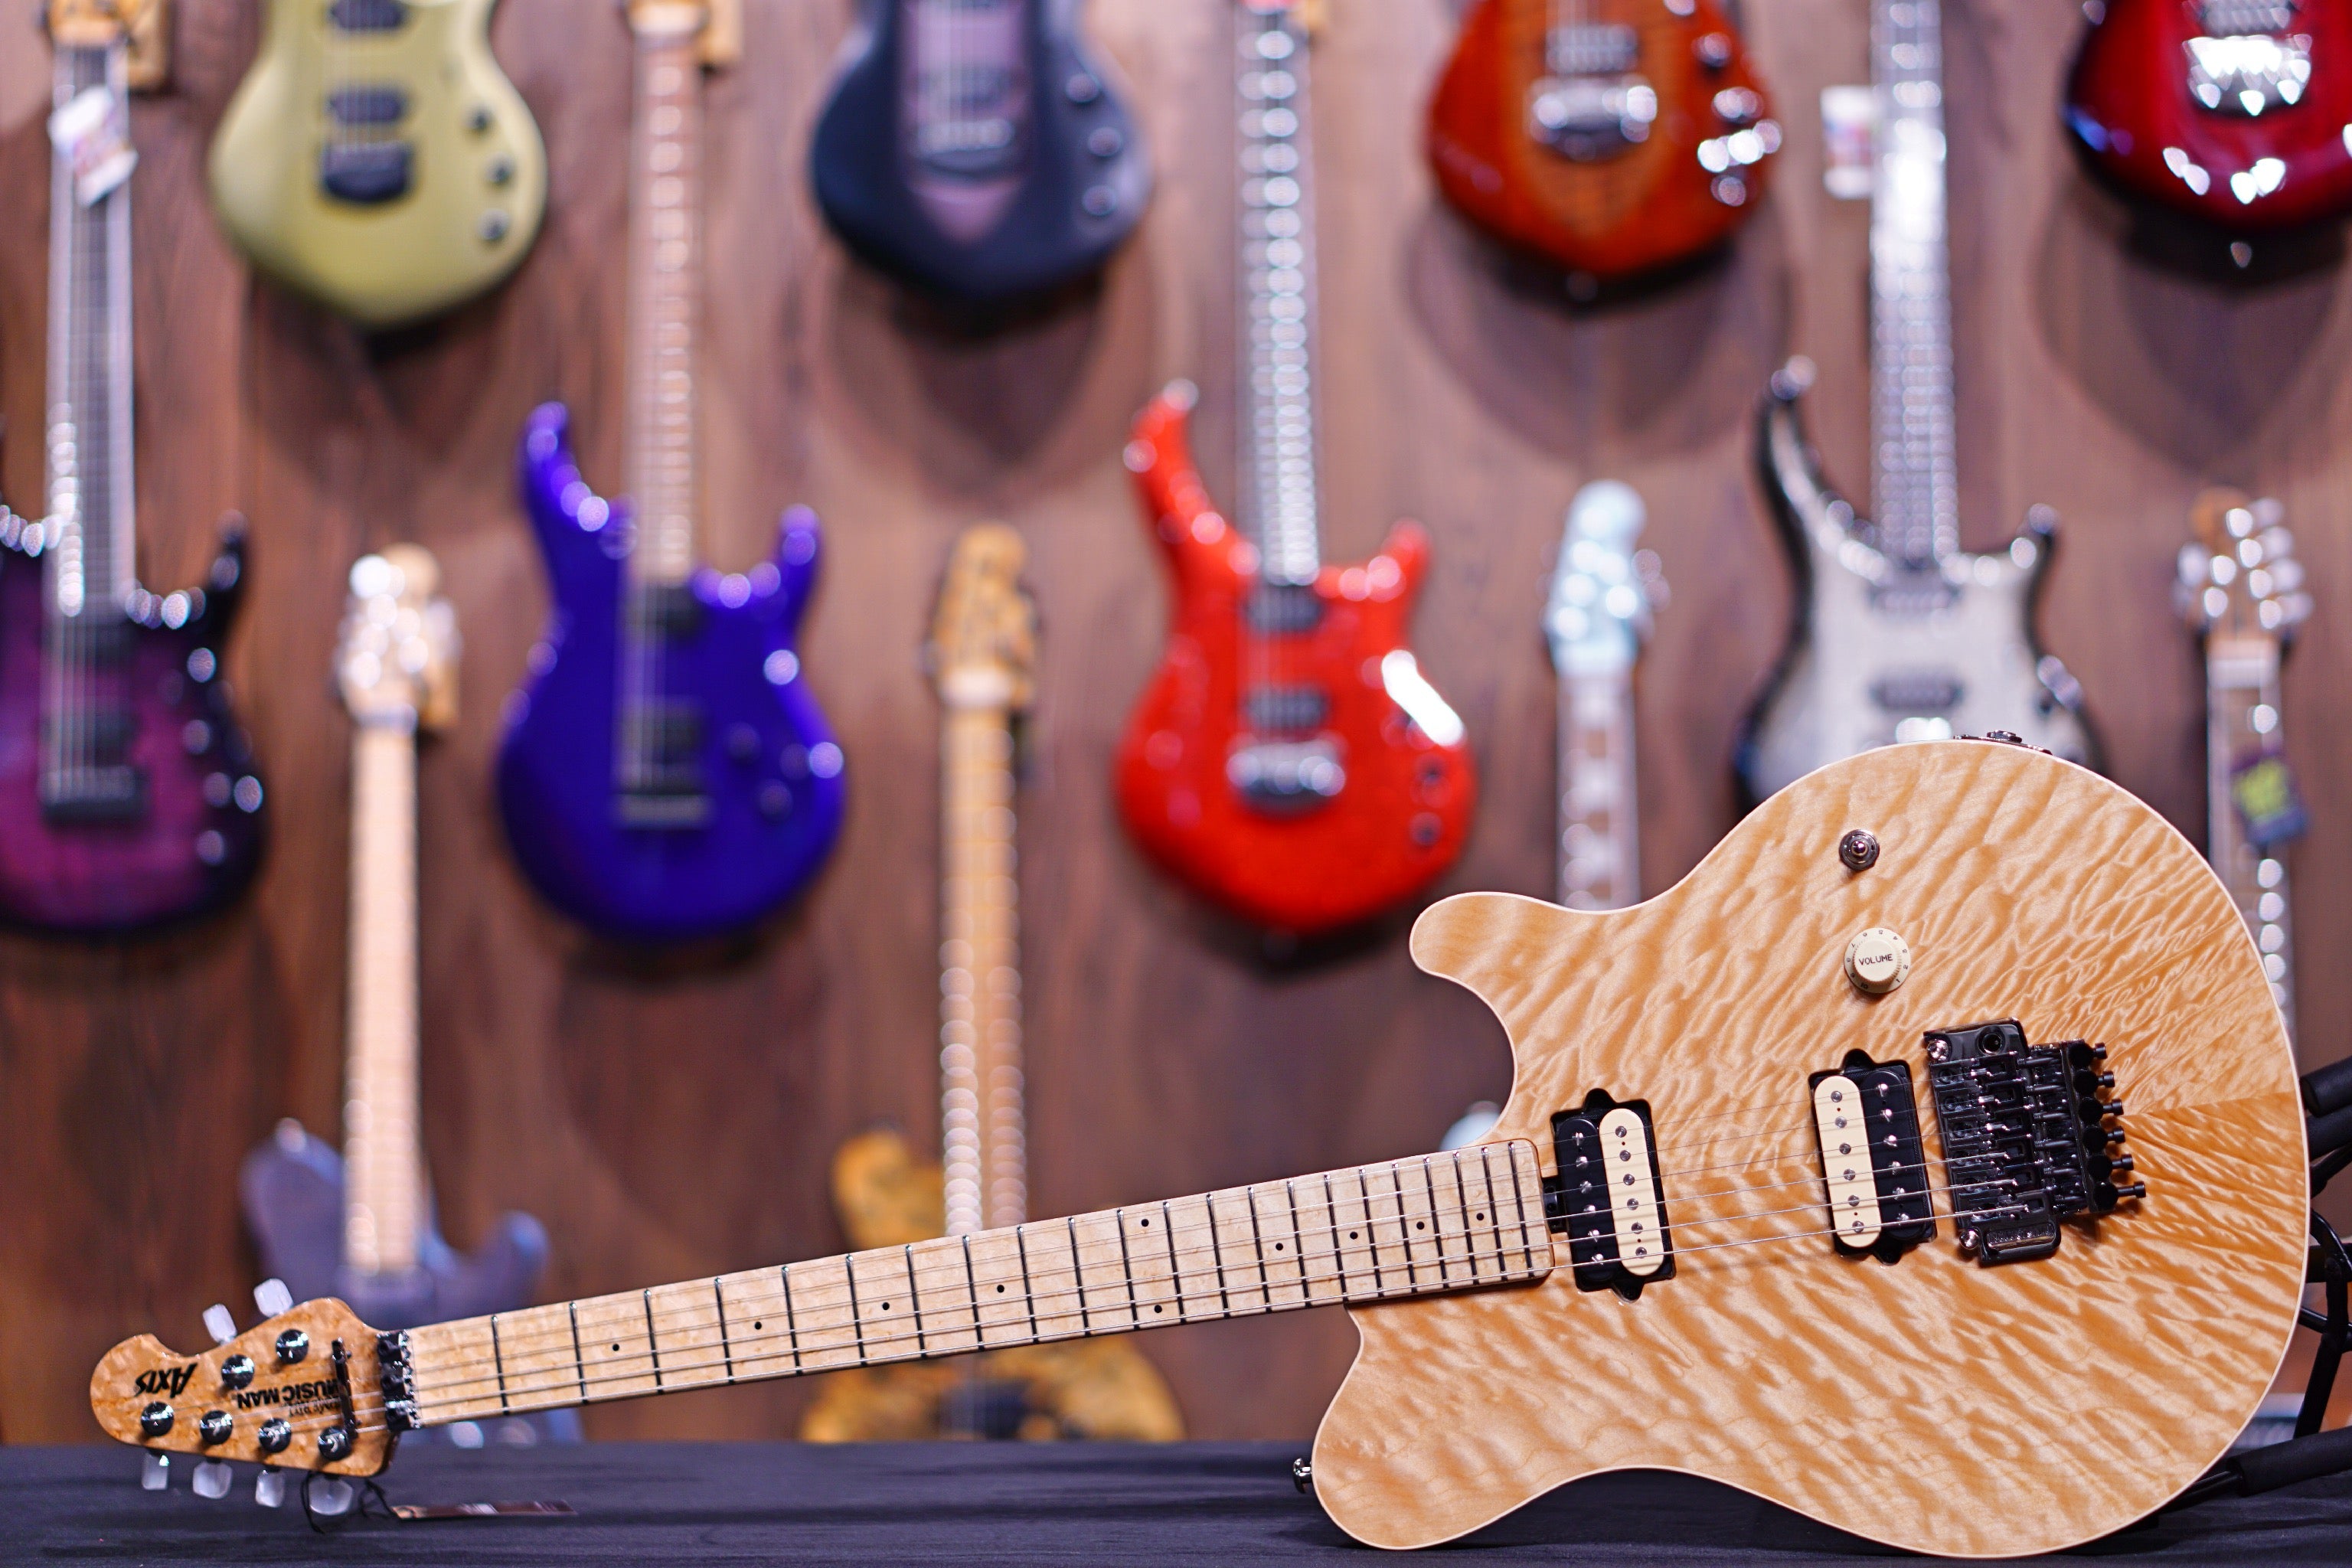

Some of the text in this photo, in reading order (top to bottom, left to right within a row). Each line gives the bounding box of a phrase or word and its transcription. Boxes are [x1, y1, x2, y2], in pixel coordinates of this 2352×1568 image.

[1859, 954, 1893, 965] VOLUME
[237, 1387, 280, 1409] MAN
[281, 1379, 340, 1402] MUSIC
